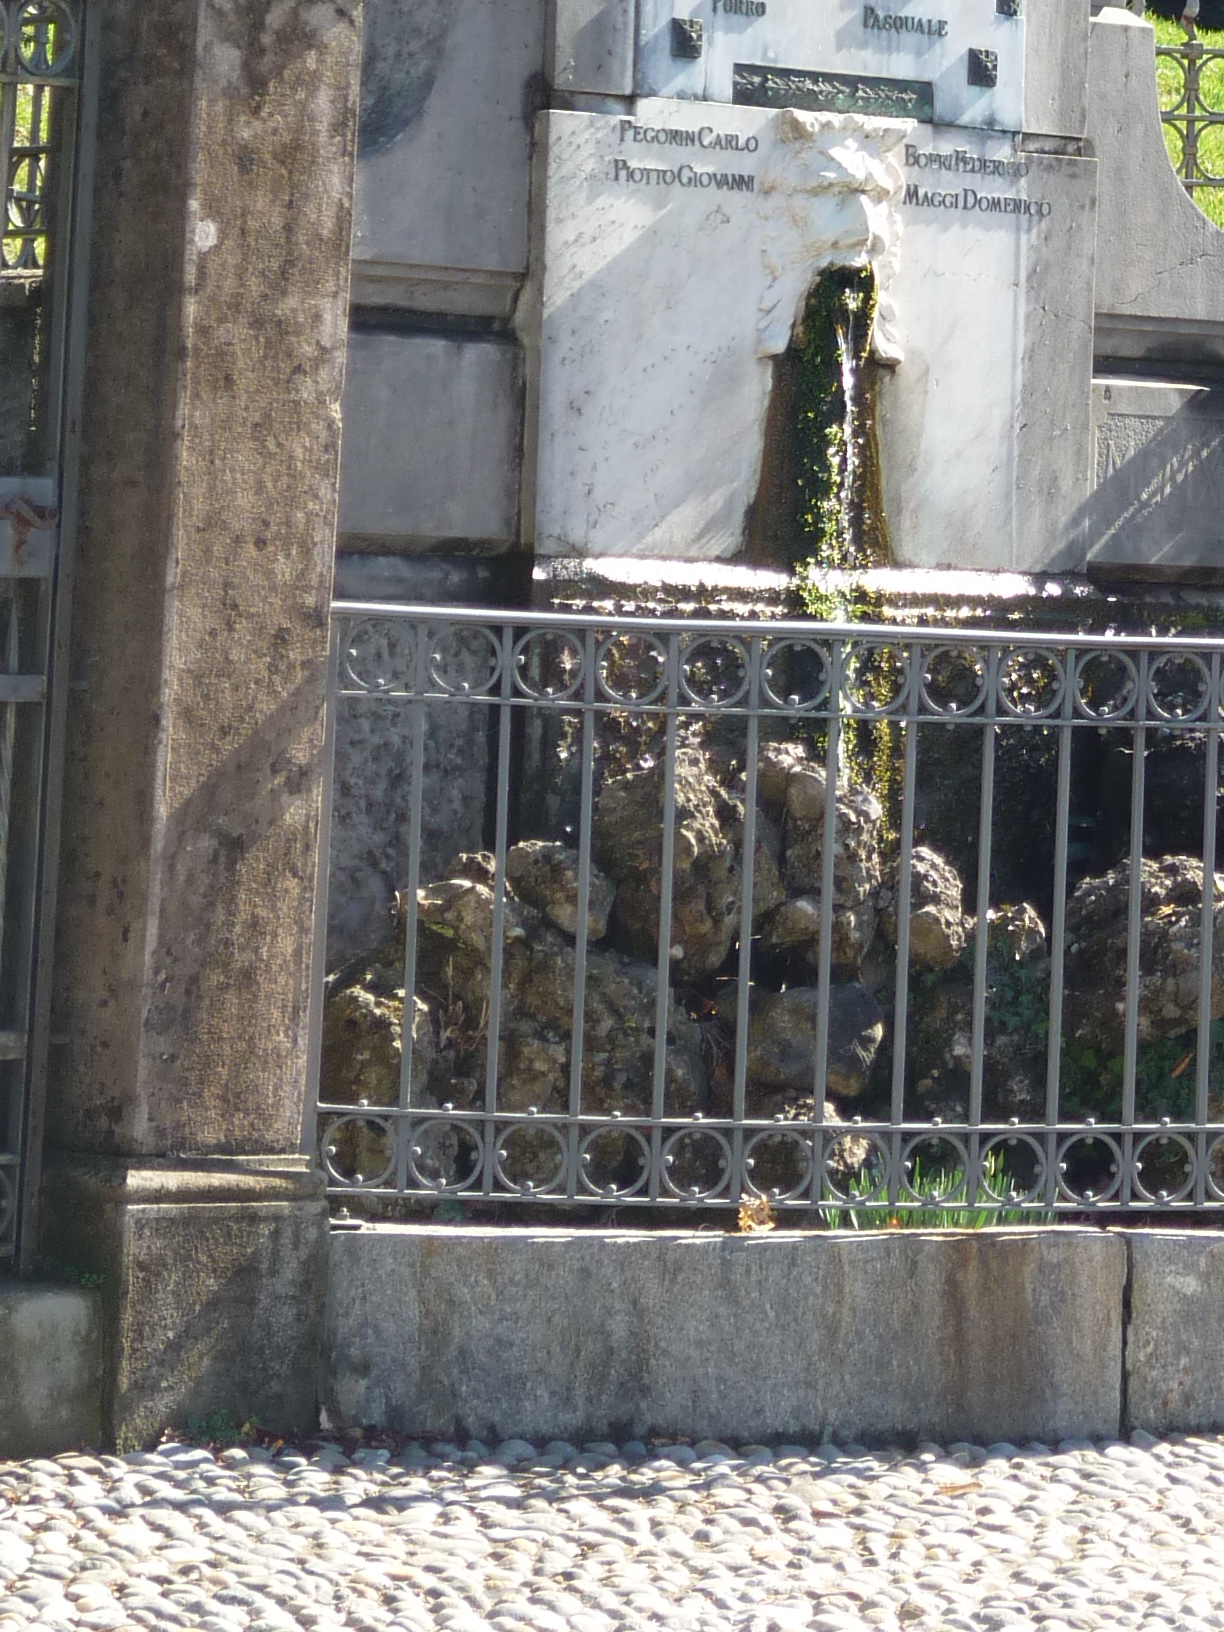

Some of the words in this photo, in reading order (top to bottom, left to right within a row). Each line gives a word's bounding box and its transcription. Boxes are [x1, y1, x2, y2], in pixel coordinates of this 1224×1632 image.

[863, 6, 948, 37] PASQUALE
[619, 119, 696, 147] PEGORIN
[698, 126, 759, 152] CARLO
[614, 158, 676, 186] PIOTTO
[677, 165, 755, 192] GIOVANNI
[954, 149, 1029, 177] FEDERICO
[903, 183, 959, 209] MAGGI
[962, 188, 1051, 217] DOMENICO
